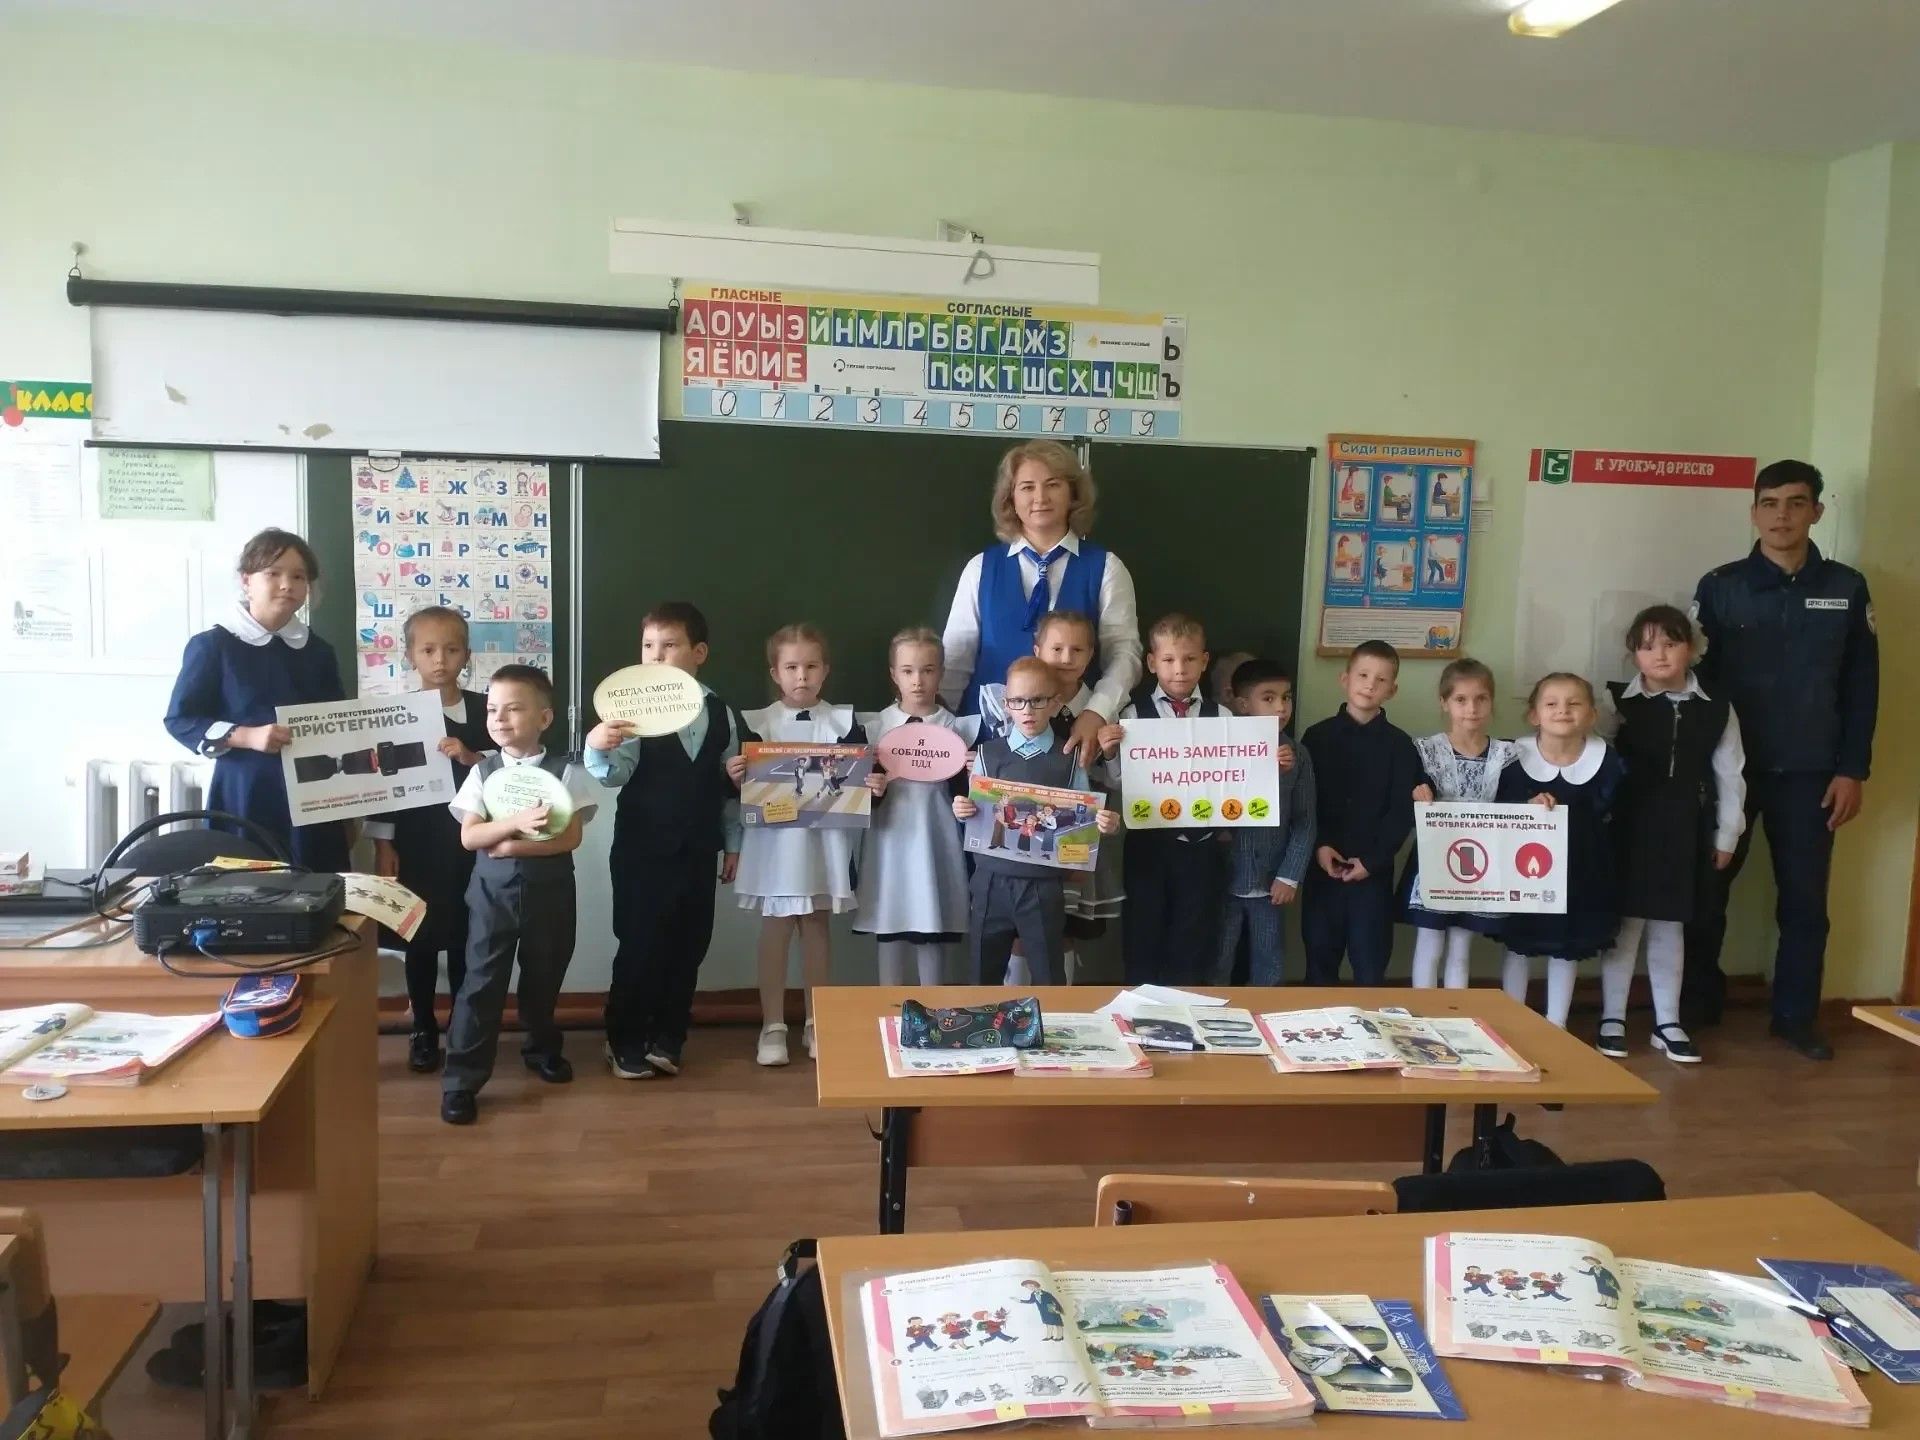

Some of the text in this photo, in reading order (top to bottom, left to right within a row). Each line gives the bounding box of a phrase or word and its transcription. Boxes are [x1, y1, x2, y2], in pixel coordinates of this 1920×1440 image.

[711, 288, 782, 303] ГЛАСНЫЕ
[947, 302, 1033, 318] СОГЛАСНЫЕ
[719, 391, 1155, 436] 0 1 2 3 4 5 6 7 8 9
[1340, 442, 1463, 458] Сиди правильно
[1594, 458, 1604, 471] К
[376, 506, 547, 527] Й К Л М Н
[377, 542, 548, 558] О П Р С Т
[377, 573, 548, 589] У Ф Х Ц Ч
[374, 603, 393, 618] Ш
[607, 682, 685, 699] ВСЕГДА СМОТРИ
[601, 702, 701, 720] НАЛЕВО И НАПРАВО
[614, 699, 628, 708] ПО
[288, 714, 320, 725] ДОРОГА
[327, 705, 407, 720] ОТВЕТСТВЕННОСТЬ
[289, 712, 419, 738] ПРИСТЕГНИСЬ
[891, 747, 950, 758] СОБЛЮДАЮ
[1129, 741, 1269, 760] СТАНЬ ЗАМЕТНЕЙ
[911, 760, 931, 768] ПДД
[1152, 769, 1246, 786] НА ДОРОГЕ!
[1425, 812, 1452, 820] ДОРОГА
[1460, 813, 1535, 821] ОТВЕТСТВЕННОСТЬ
[1426, 820, 1557, 831] НЕ ОТВЛЕКАЙСЯ НА ГАДЖЕТЫ
